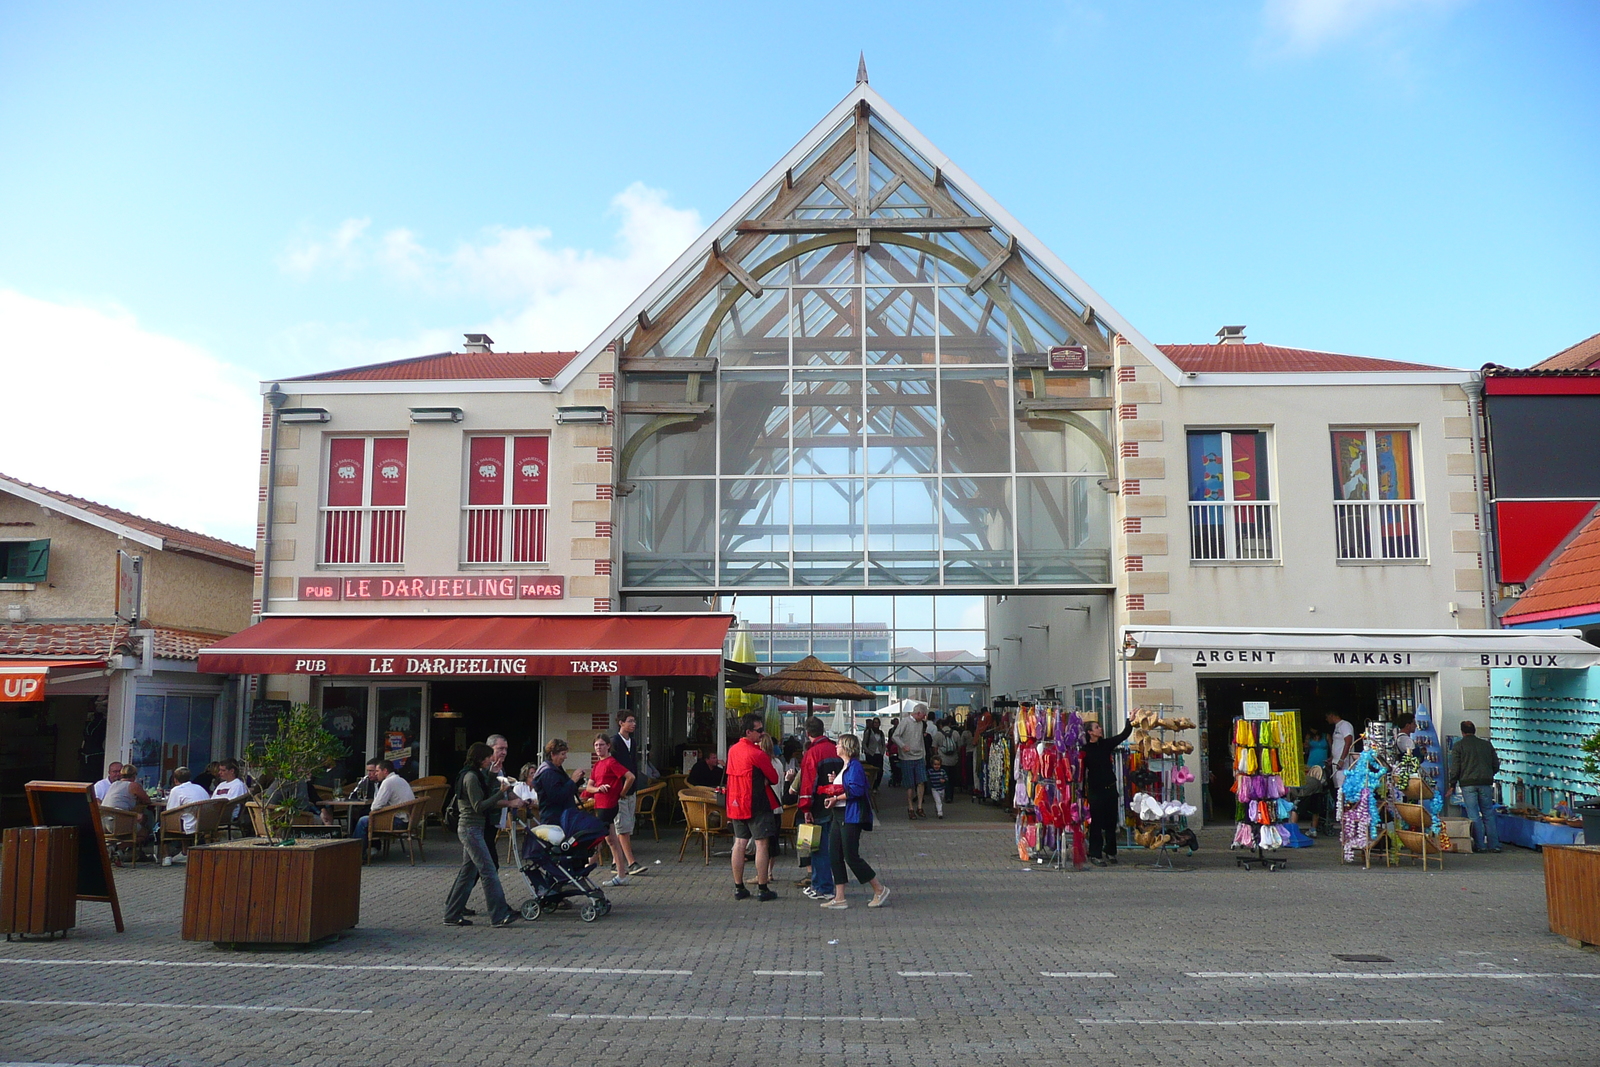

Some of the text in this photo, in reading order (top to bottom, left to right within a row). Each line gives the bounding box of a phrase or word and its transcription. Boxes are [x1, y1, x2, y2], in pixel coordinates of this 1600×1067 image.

[305, 586, 333, 597] PUB
[346, 578, 514, 598] LE DARJEELING
[520, 584, 561, 596] TAPAS
[295, 658, 618, 674] PUB LE DARJEELING TAPAS
[1196, 651, 1558, 667] ARGENT MAKASI BIJOUX
[4, 678, 38, 698] UP
